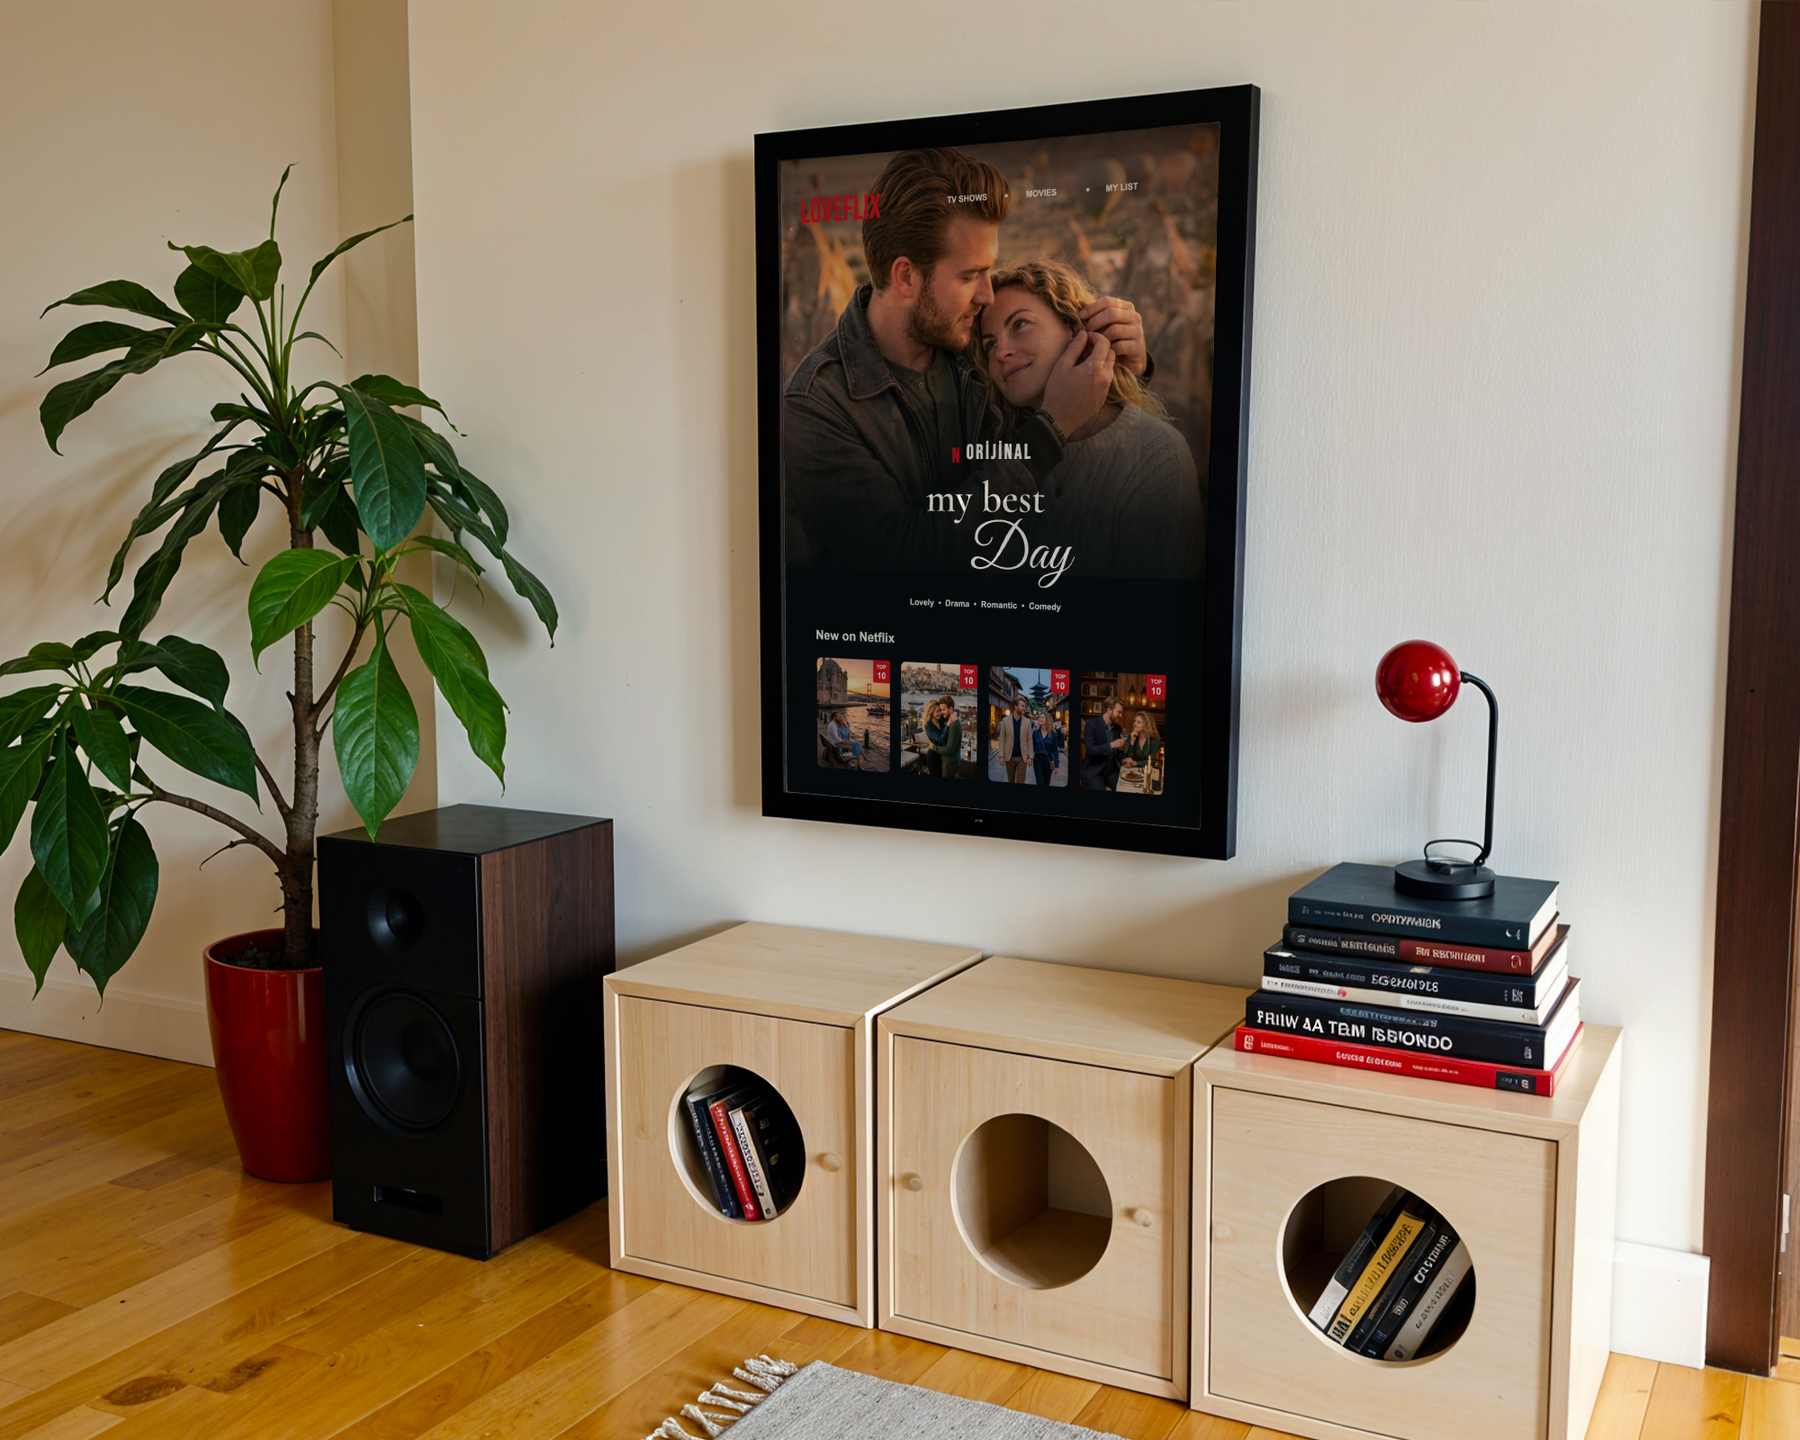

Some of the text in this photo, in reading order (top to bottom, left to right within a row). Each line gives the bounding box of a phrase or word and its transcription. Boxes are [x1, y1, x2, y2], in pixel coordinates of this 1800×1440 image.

[946, 182, 1139, 204] TV SHOWS MOVIES MY LIST
[800, 192, 882, 224] LOVEFLIX
[926, 478, 1046, 525] my best
[970, 517, 1076, 589] Day
[909, 598, 1062, 613] Lovely Drama Romantic Comedy
[815, 629, 895, 644] New on Netflix
[877, 671, 887, 680] 10
[964, 676, 974, 685] 10
[1053, 672, 1067, 680] TOP
[1149, 677, 1163, 685] TOP
[1055, 681, 1066, 690] 10
[1151, 686, 1162, 696] 10
